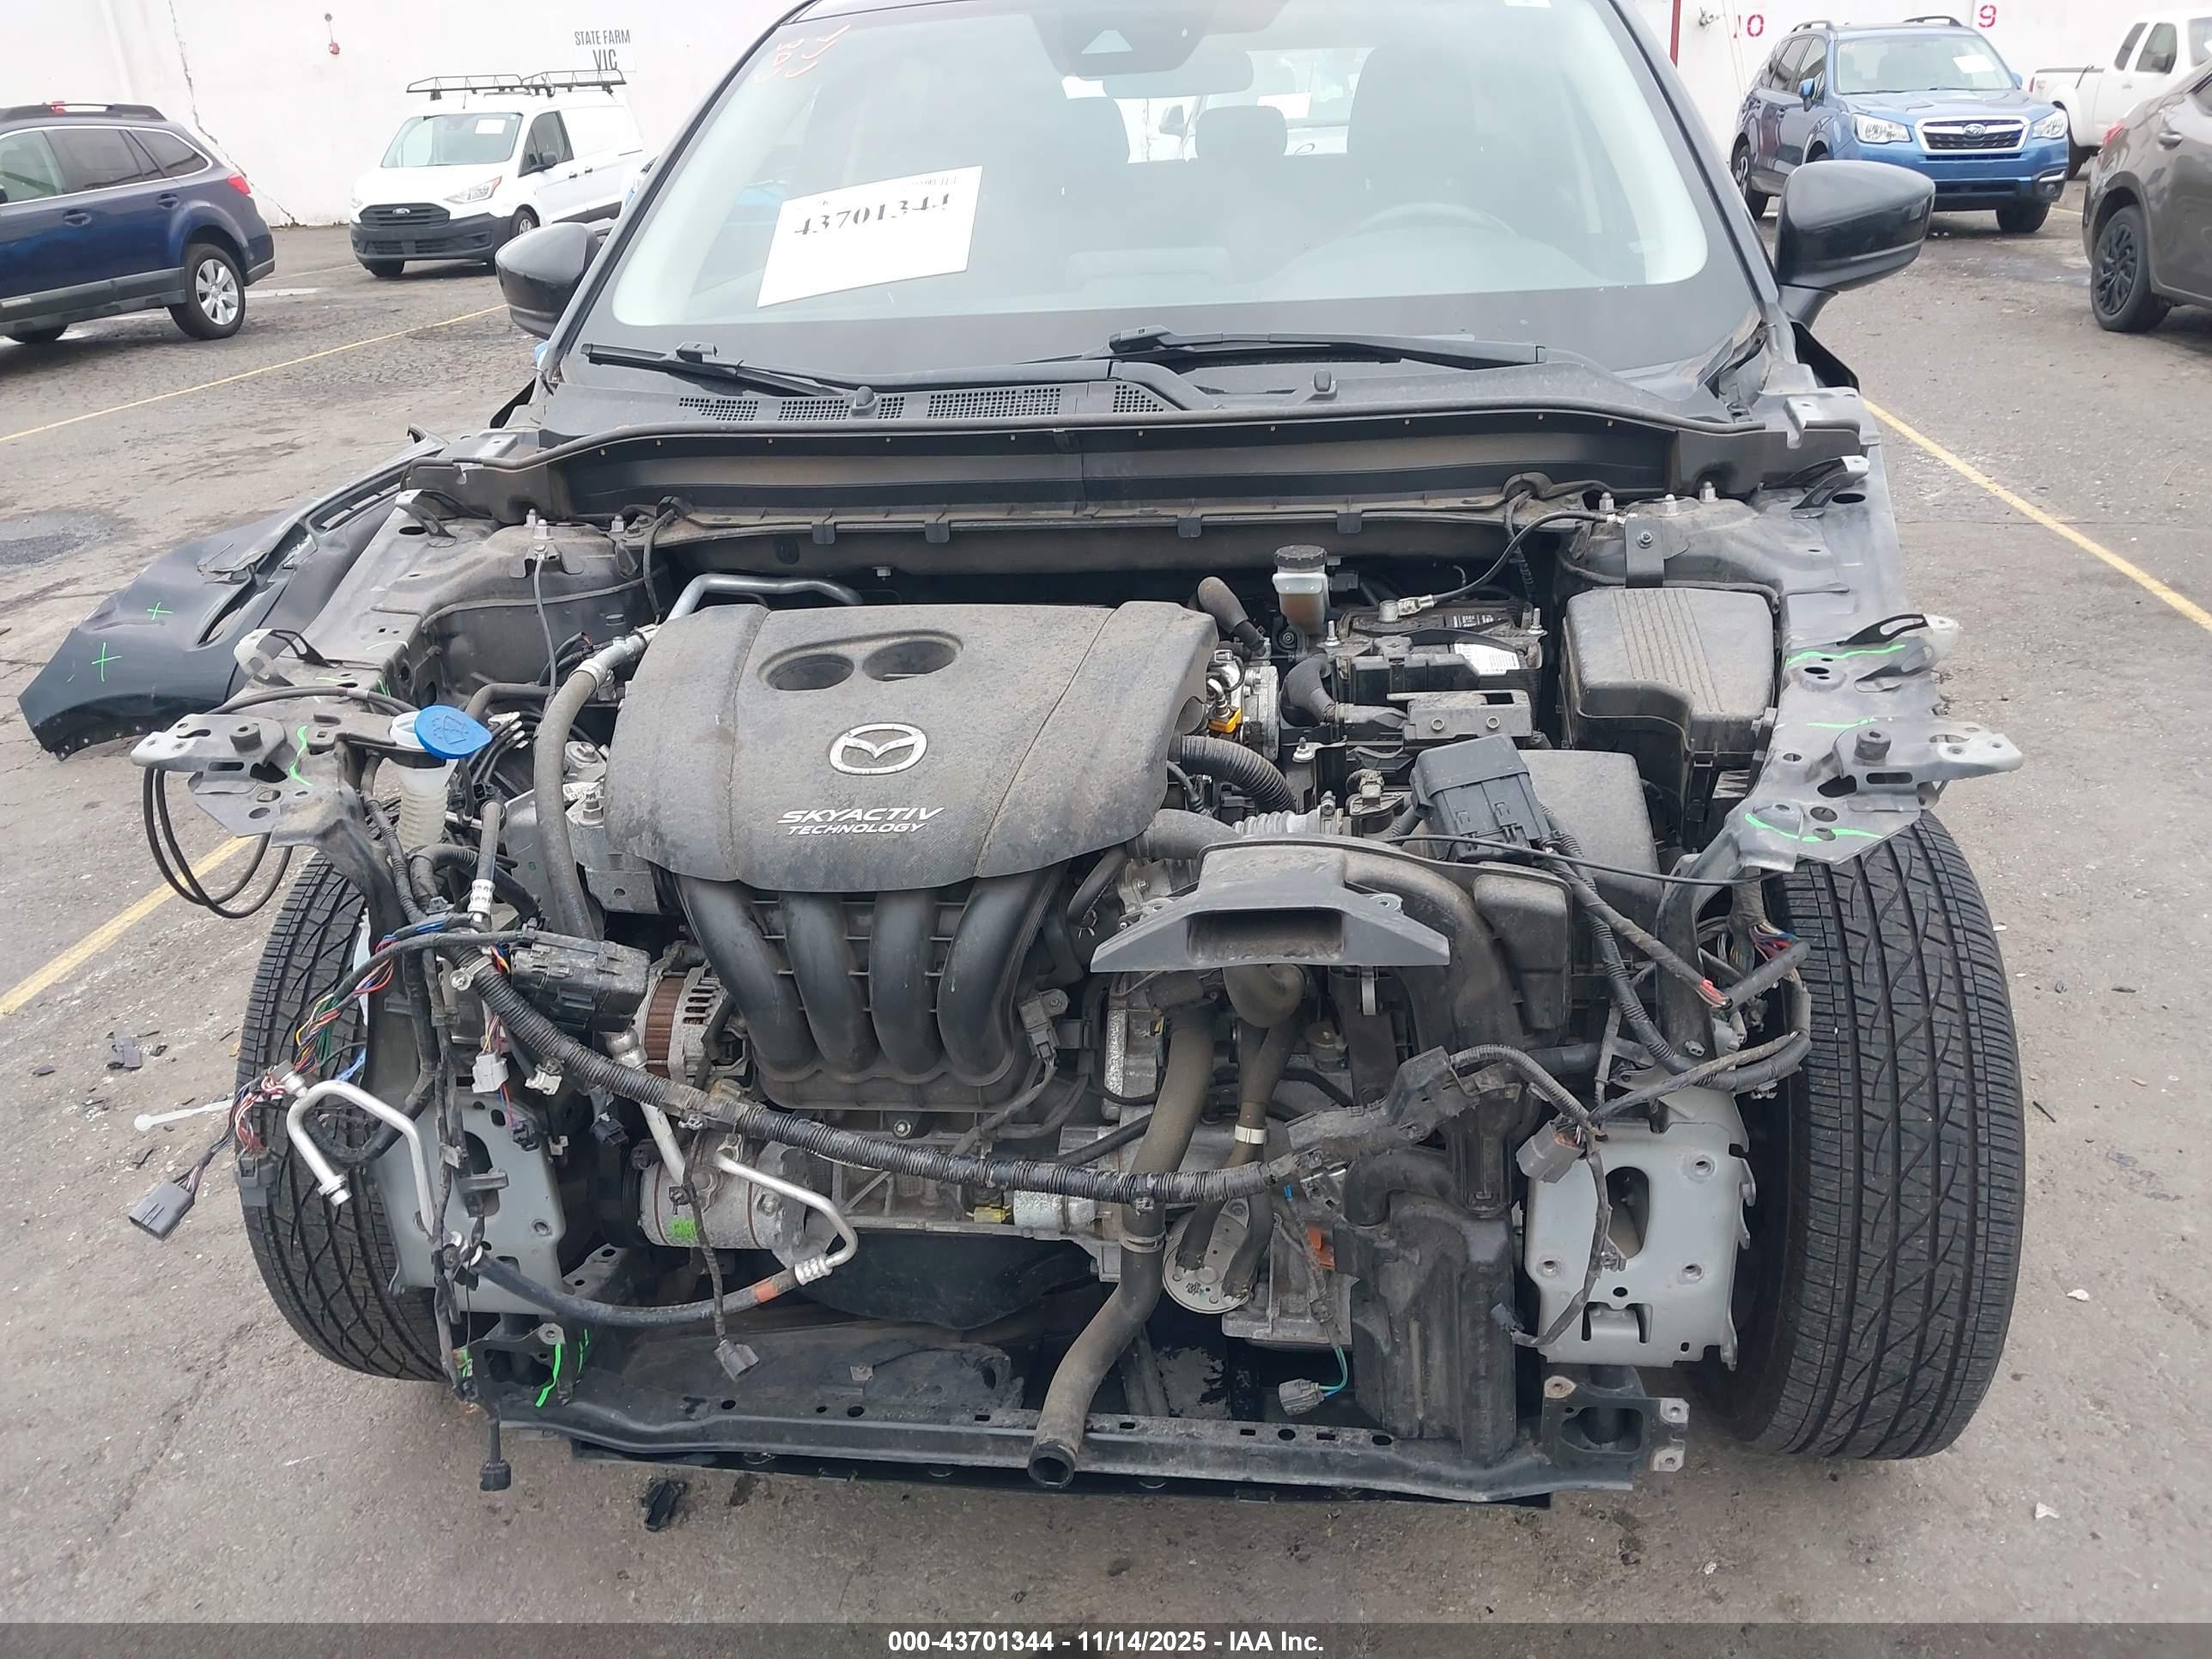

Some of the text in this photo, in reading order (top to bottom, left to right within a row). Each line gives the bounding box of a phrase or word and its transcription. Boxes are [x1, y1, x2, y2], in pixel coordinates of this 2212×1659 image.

[1978, 4, 1996, 28] 9
[574, 28, 631, 46] STATE FARM
[592, 48, 618, 70] VIC
[776, 806, 945, 824] SKYACTIV
[787, 822, 927, 836] TECHNOLOGY
